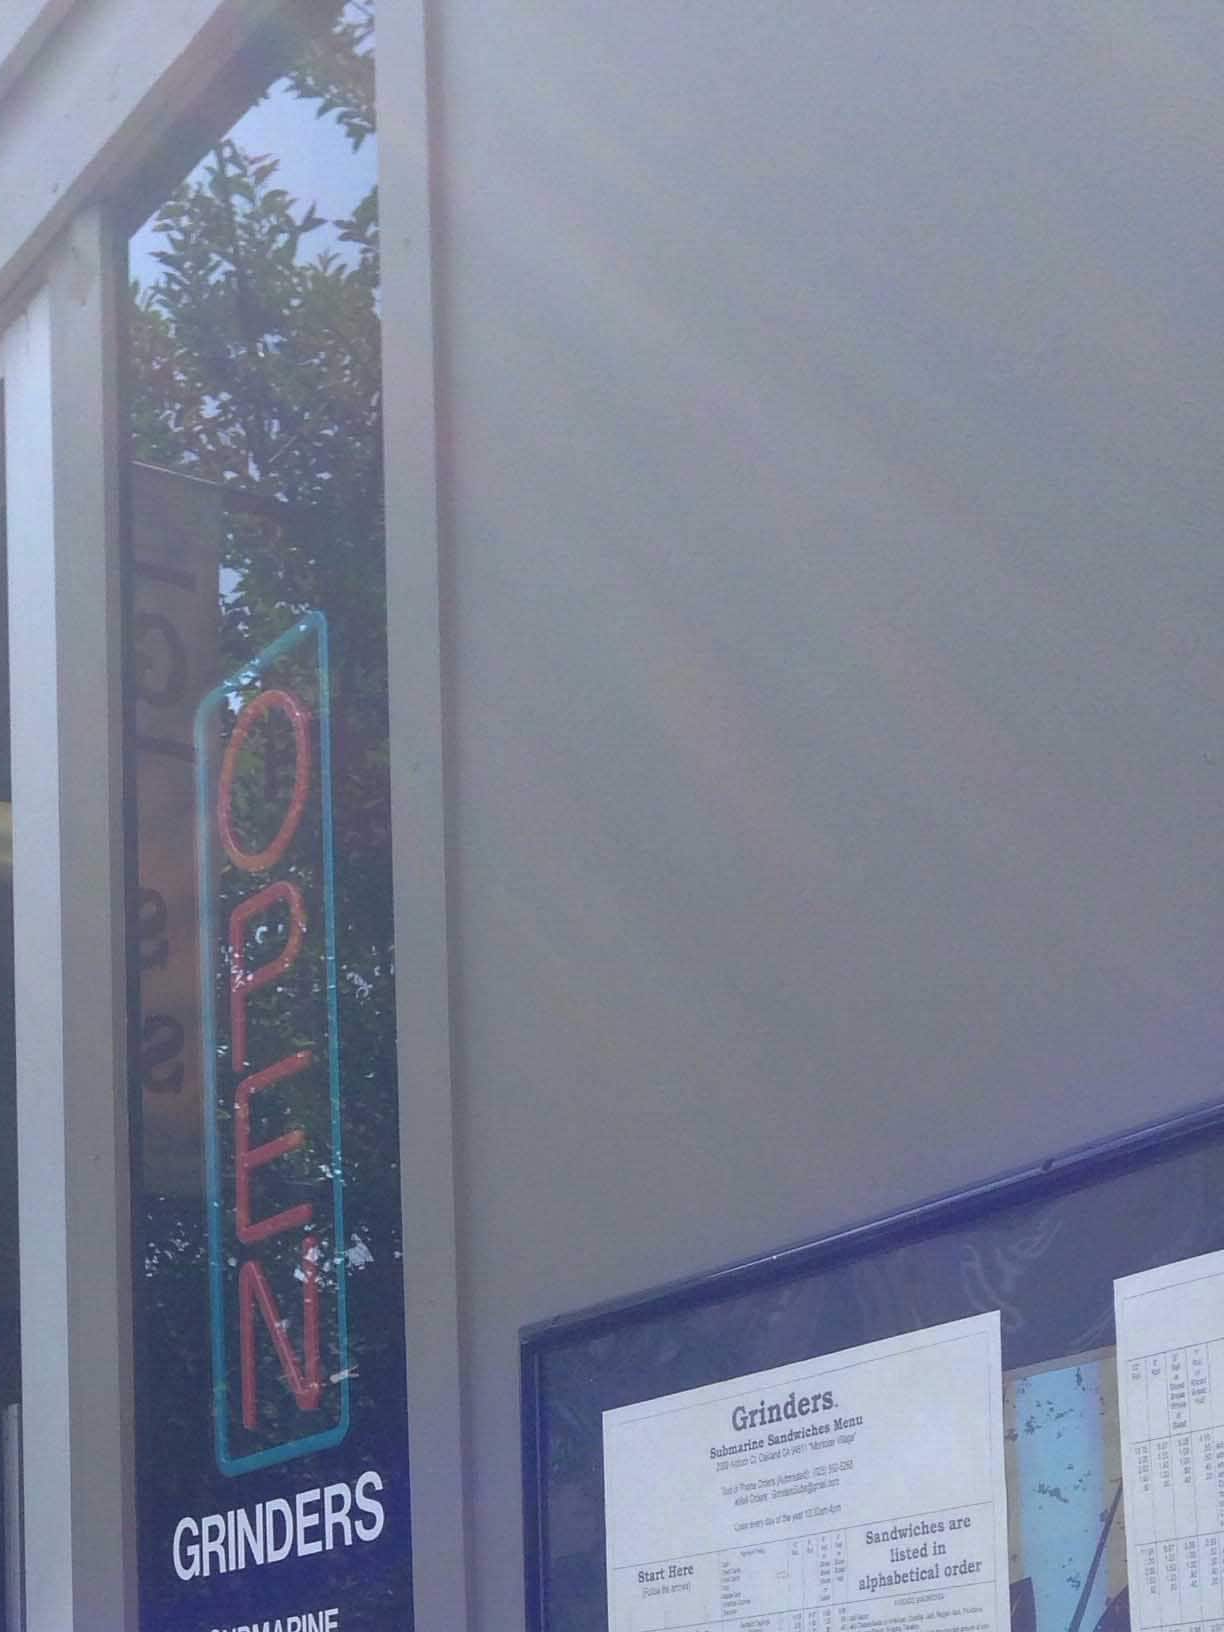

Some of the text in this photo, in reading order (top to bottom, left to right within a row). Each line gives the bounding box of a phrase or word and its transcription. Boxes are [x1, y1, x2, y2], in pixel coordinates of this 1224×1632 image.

[217, 689, 320, 1433] OPEN
[710, 1439, 765, 1460] Submarine
[768, 1424, 830, 1447] Sandwiches
[833, 1414, 864, 1432] Menu
[173, 1470, 386, 1580] GRINDERS
[865, 1516, 971, 1545] Sandwiches are
[890, 1541, 946, 1563] listed in
[638, 1564, 694, 1584] Start Here
[858, 1559, 983, 1592] alphabetical order
